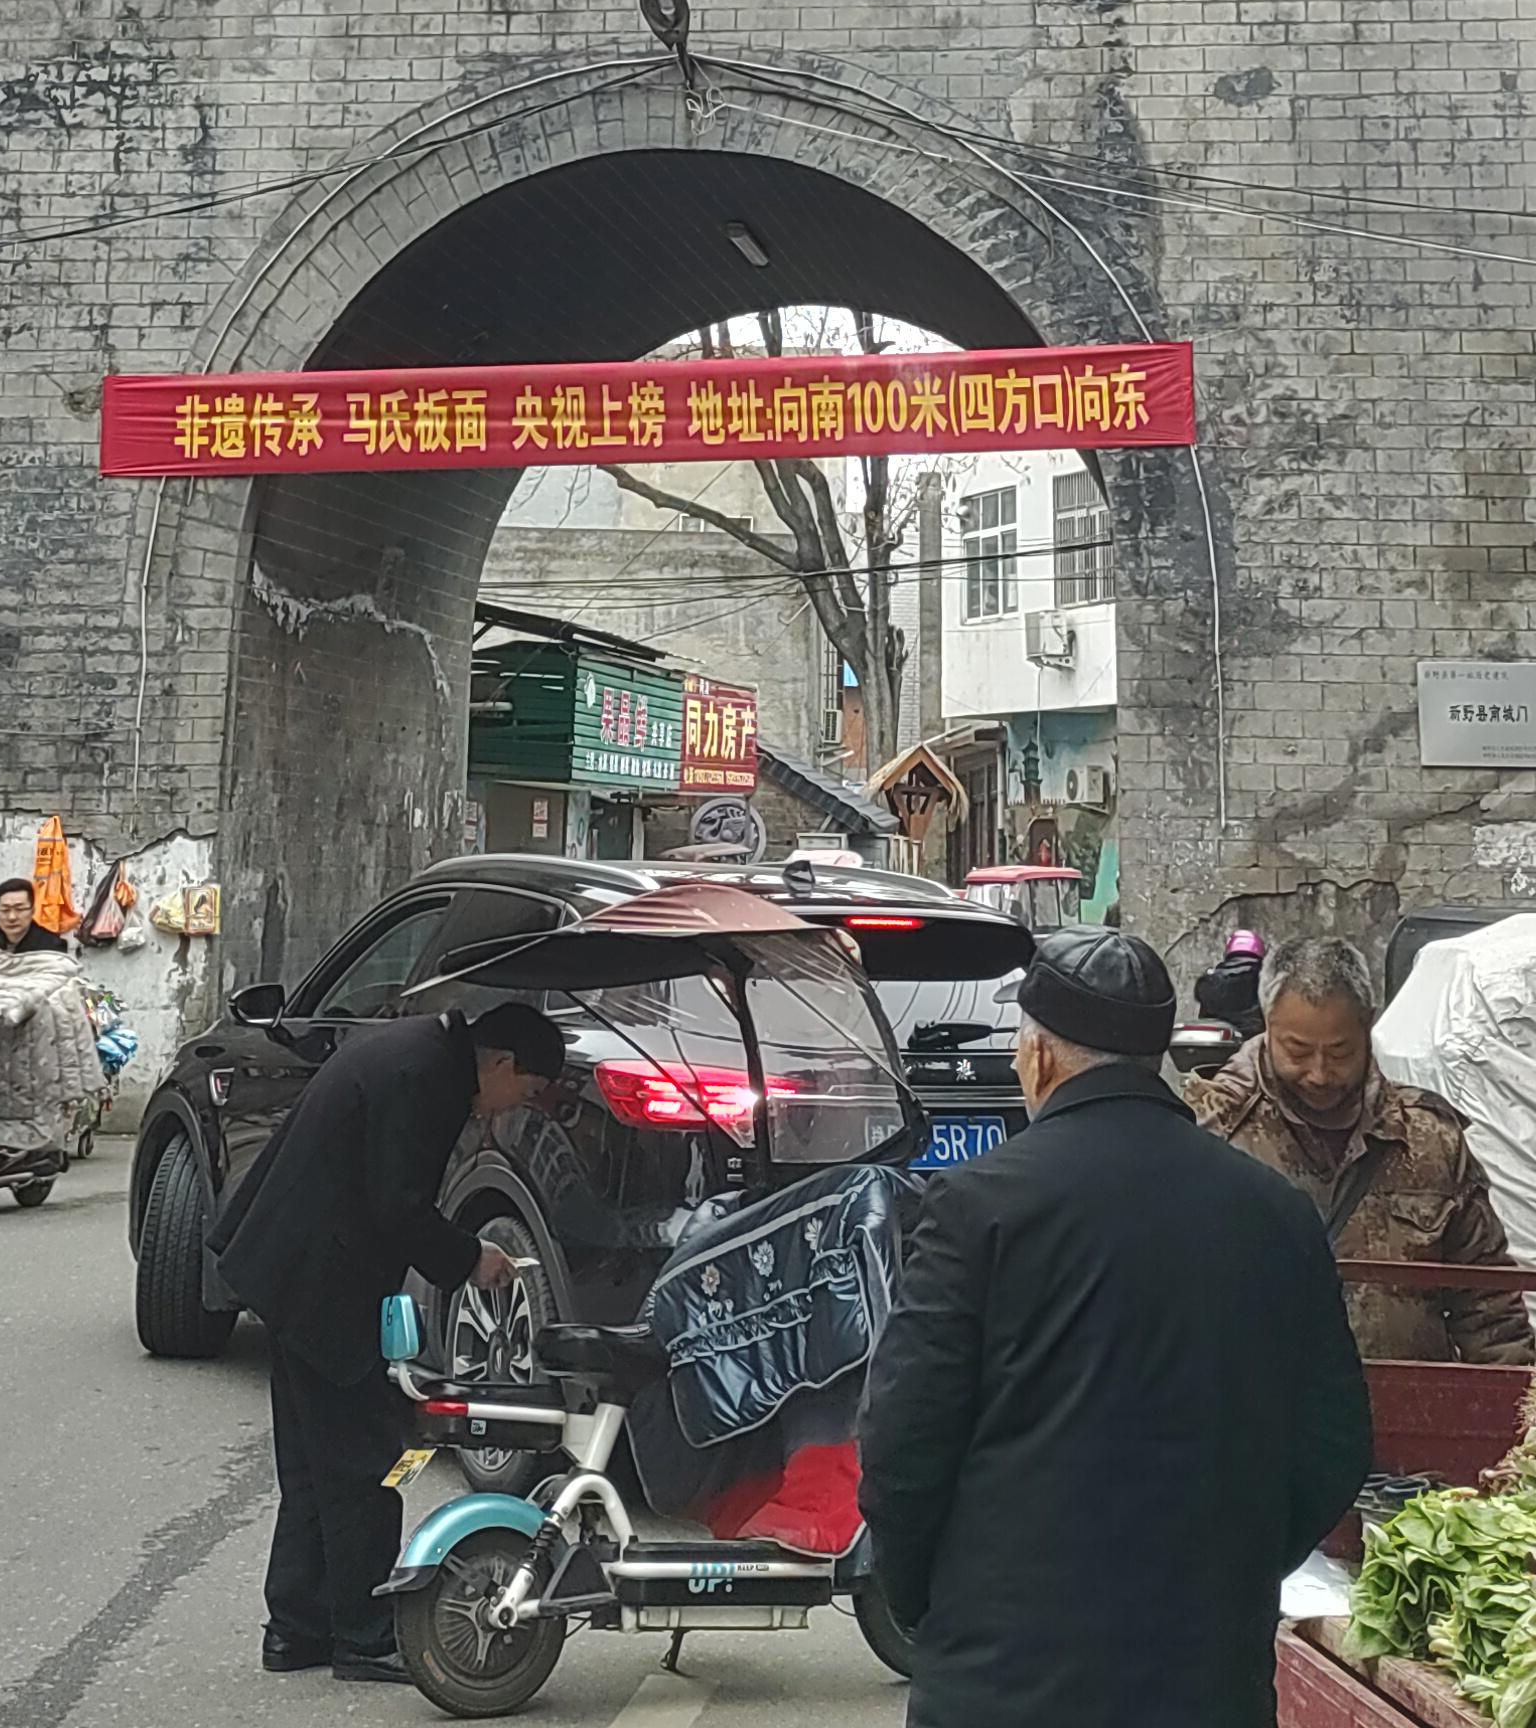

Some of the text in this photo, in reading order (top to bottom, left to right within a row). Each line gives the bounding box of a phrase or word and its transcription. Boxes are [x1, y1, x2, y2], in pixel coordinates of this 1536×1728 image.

[173, 391, 324, 459] 非遗传承
[343, 388, 488, 455] 马氏板面
[511, 380, 666, 451] 央视上榜
[685, 698, 756, 761] 同力房产
[922, 1124, 1004, 1162] 5R70
